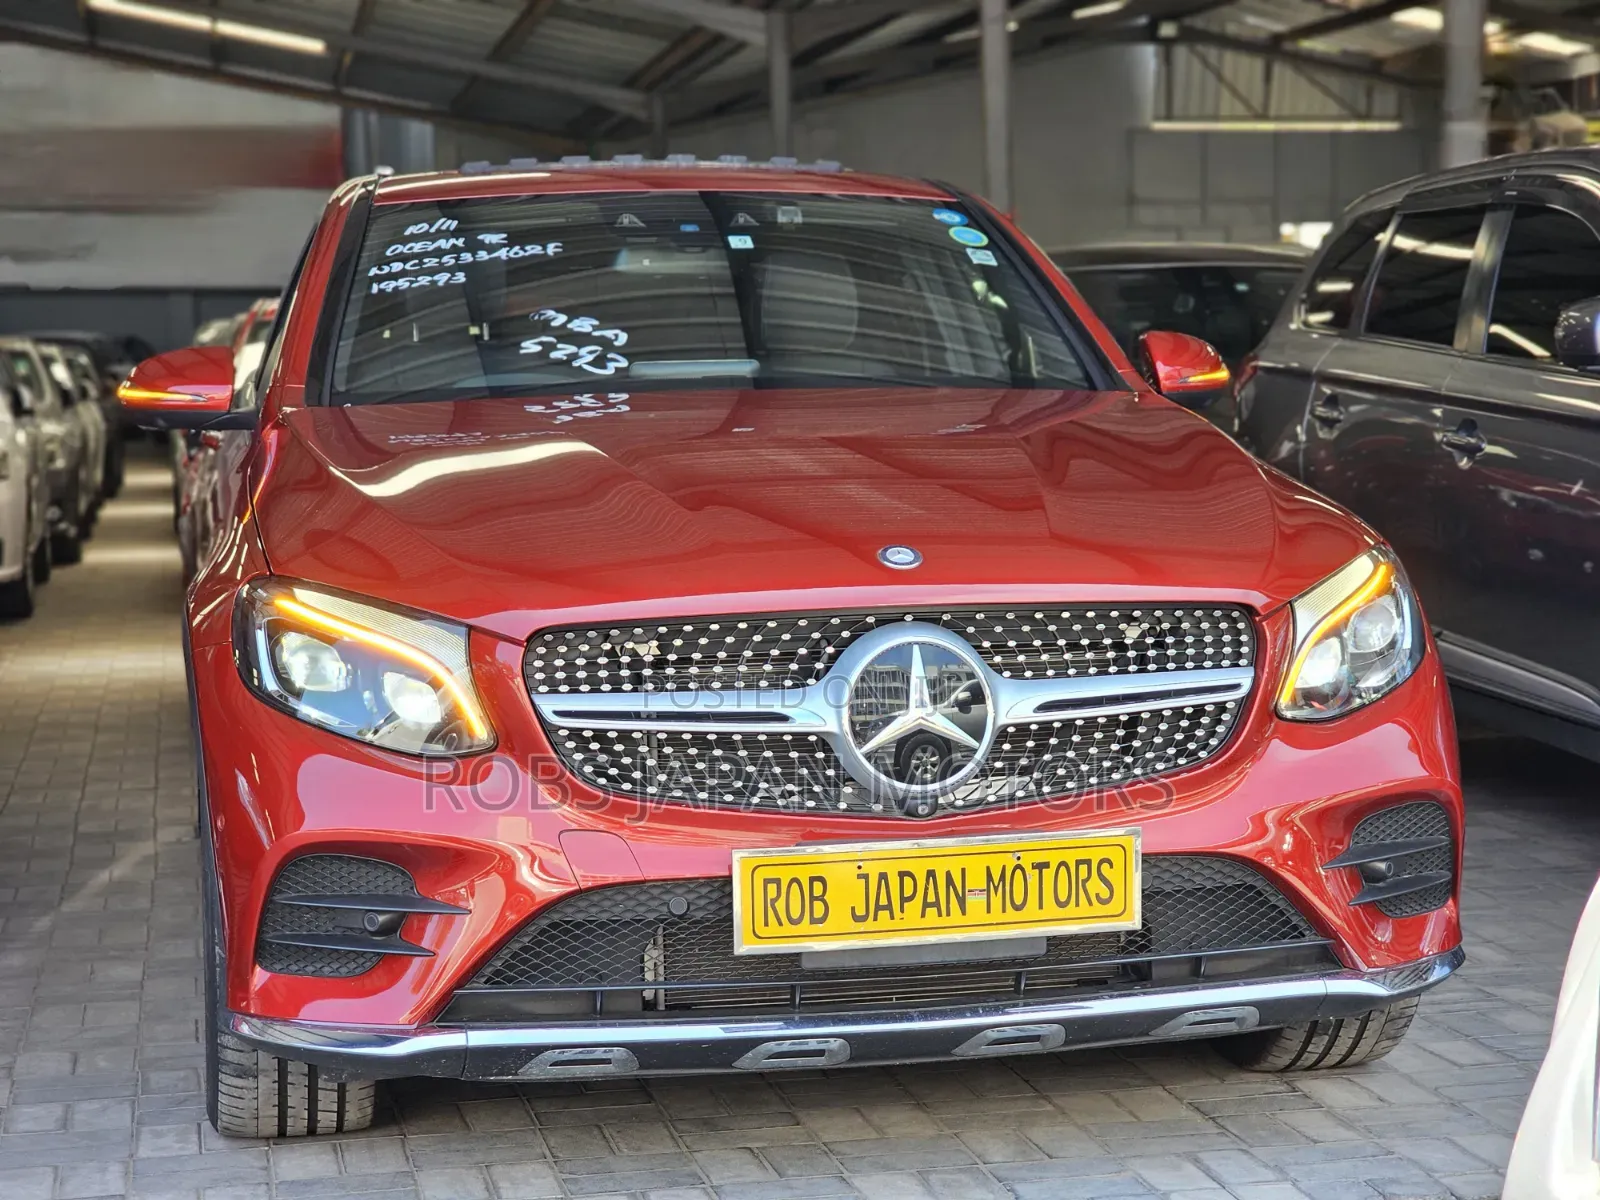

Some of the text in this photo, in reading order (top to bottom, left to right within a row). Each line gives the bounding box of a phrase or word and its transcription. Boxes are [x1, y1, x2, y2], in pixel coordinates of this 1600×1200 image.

[403, 217, 459, 236] 10/11
[385, 237, 465, 256] OCEAN
[371, 271, 467, 294] 195293
[518, 335, 629, 375] 5293
[762, 857, 1115, 928] ROB JAPAN MOTORS
